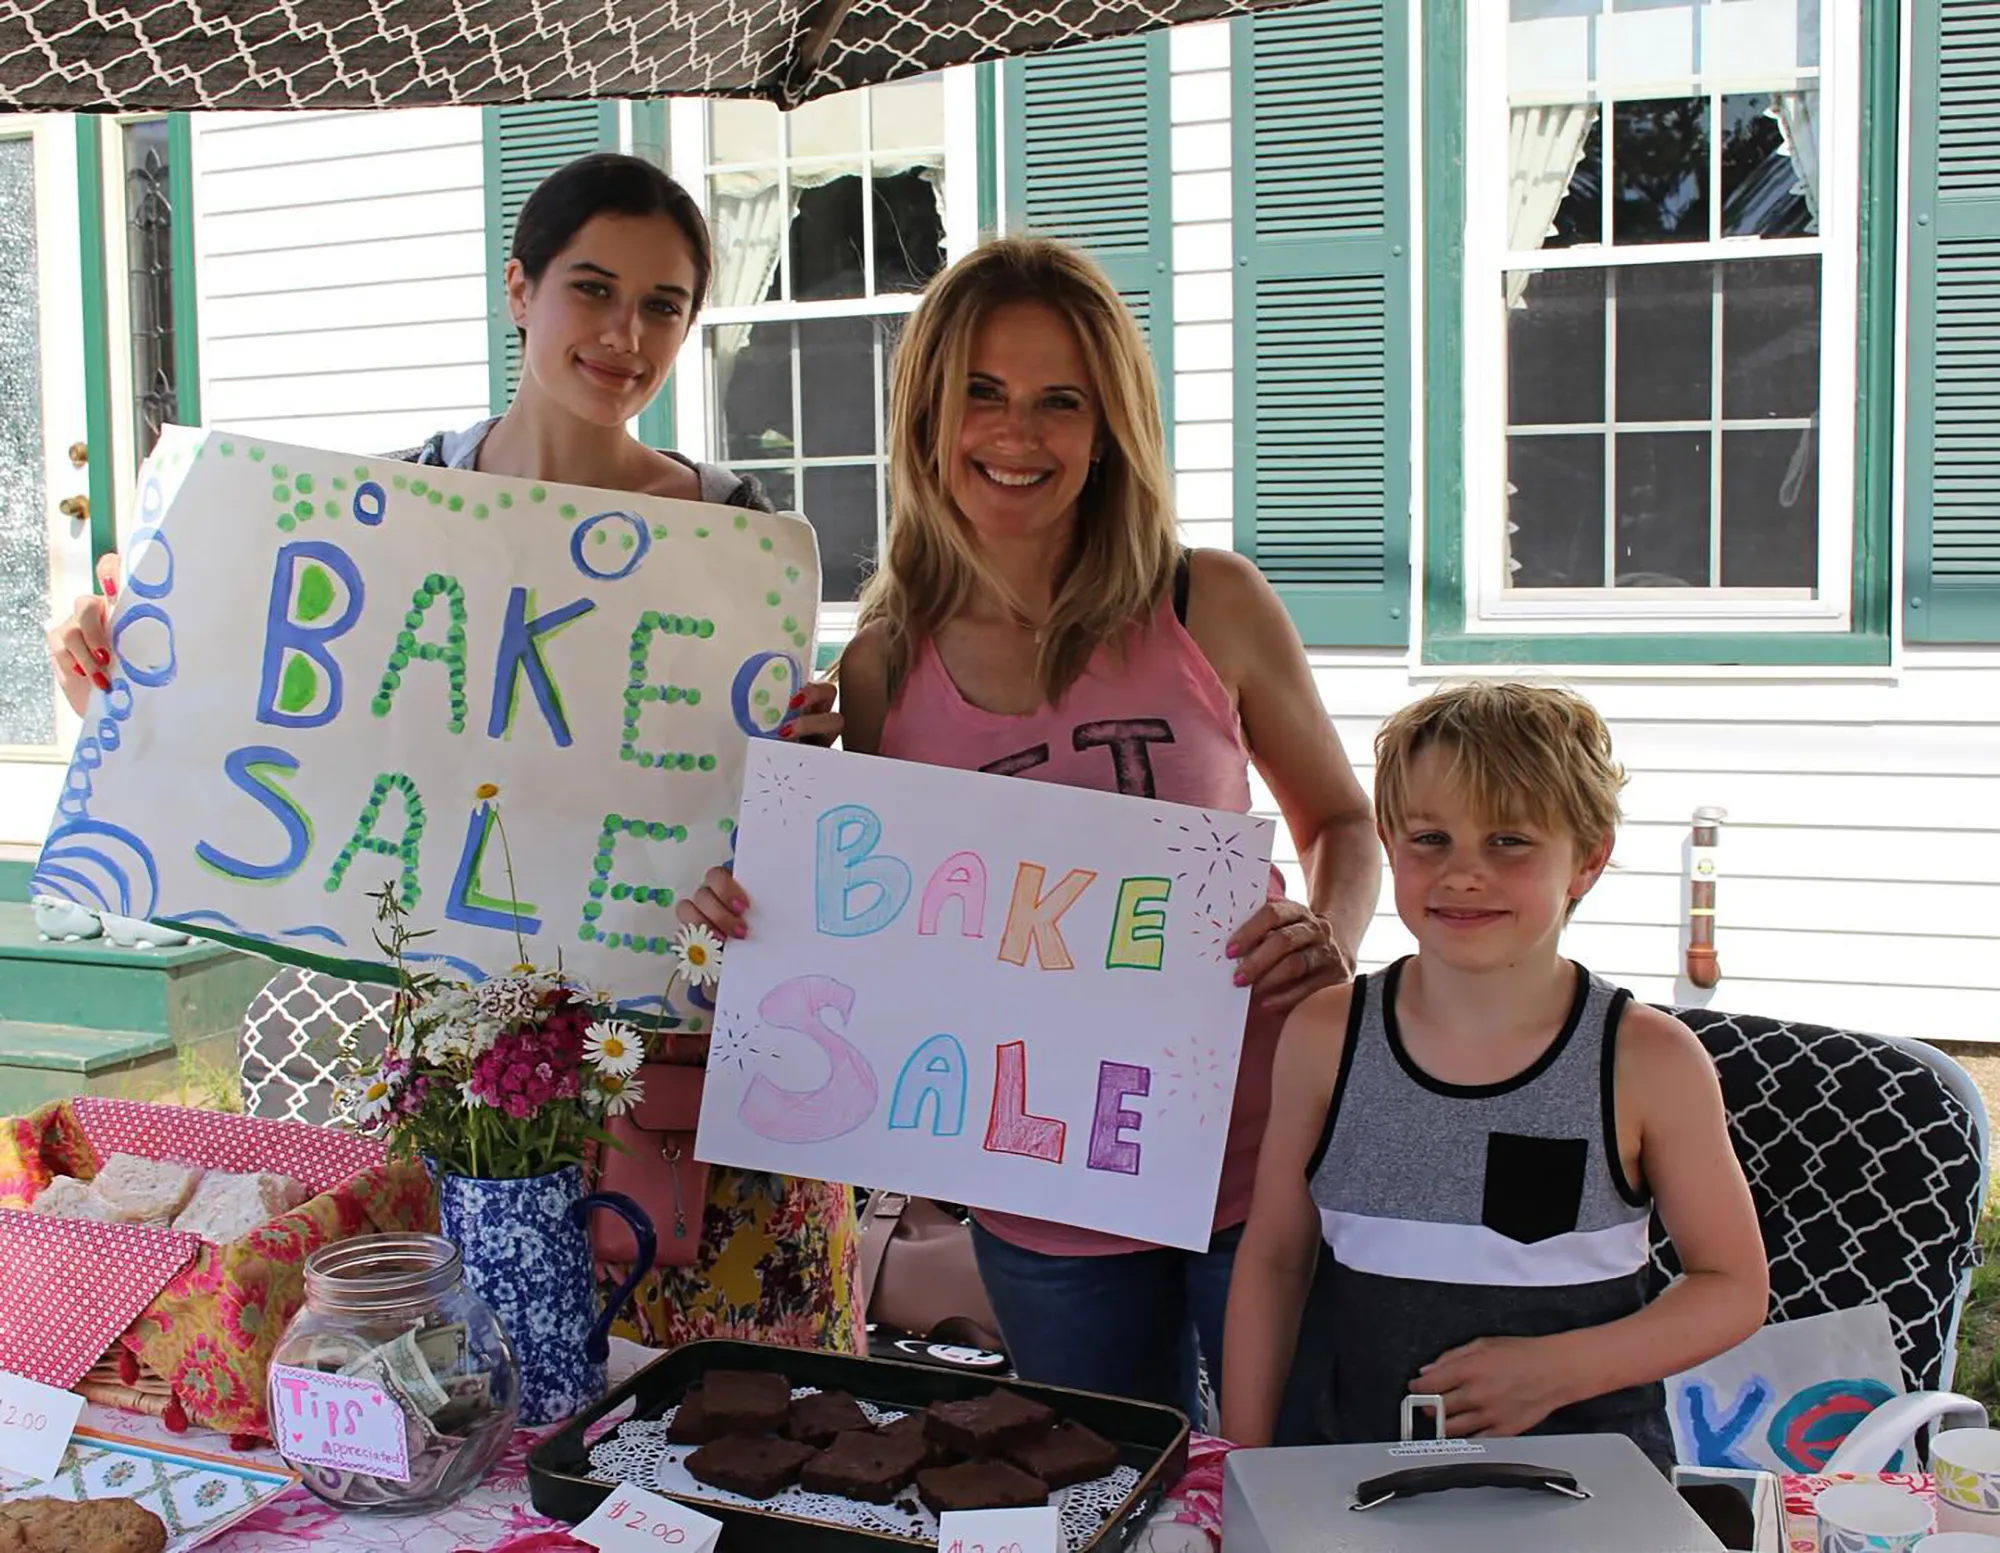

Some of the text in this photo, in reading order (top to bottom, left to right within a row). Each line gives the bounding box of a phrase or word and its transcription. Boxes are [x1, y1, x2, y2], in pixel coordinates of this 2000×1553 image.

[256, 541, 717, 771] BAKE
[194, 745, 688, 954] SALE
[817, 805, 1172, 970] BAKE
[738, 974, 1151, 1175] SALE
[607, 1500, 685, 1544] $2.00
